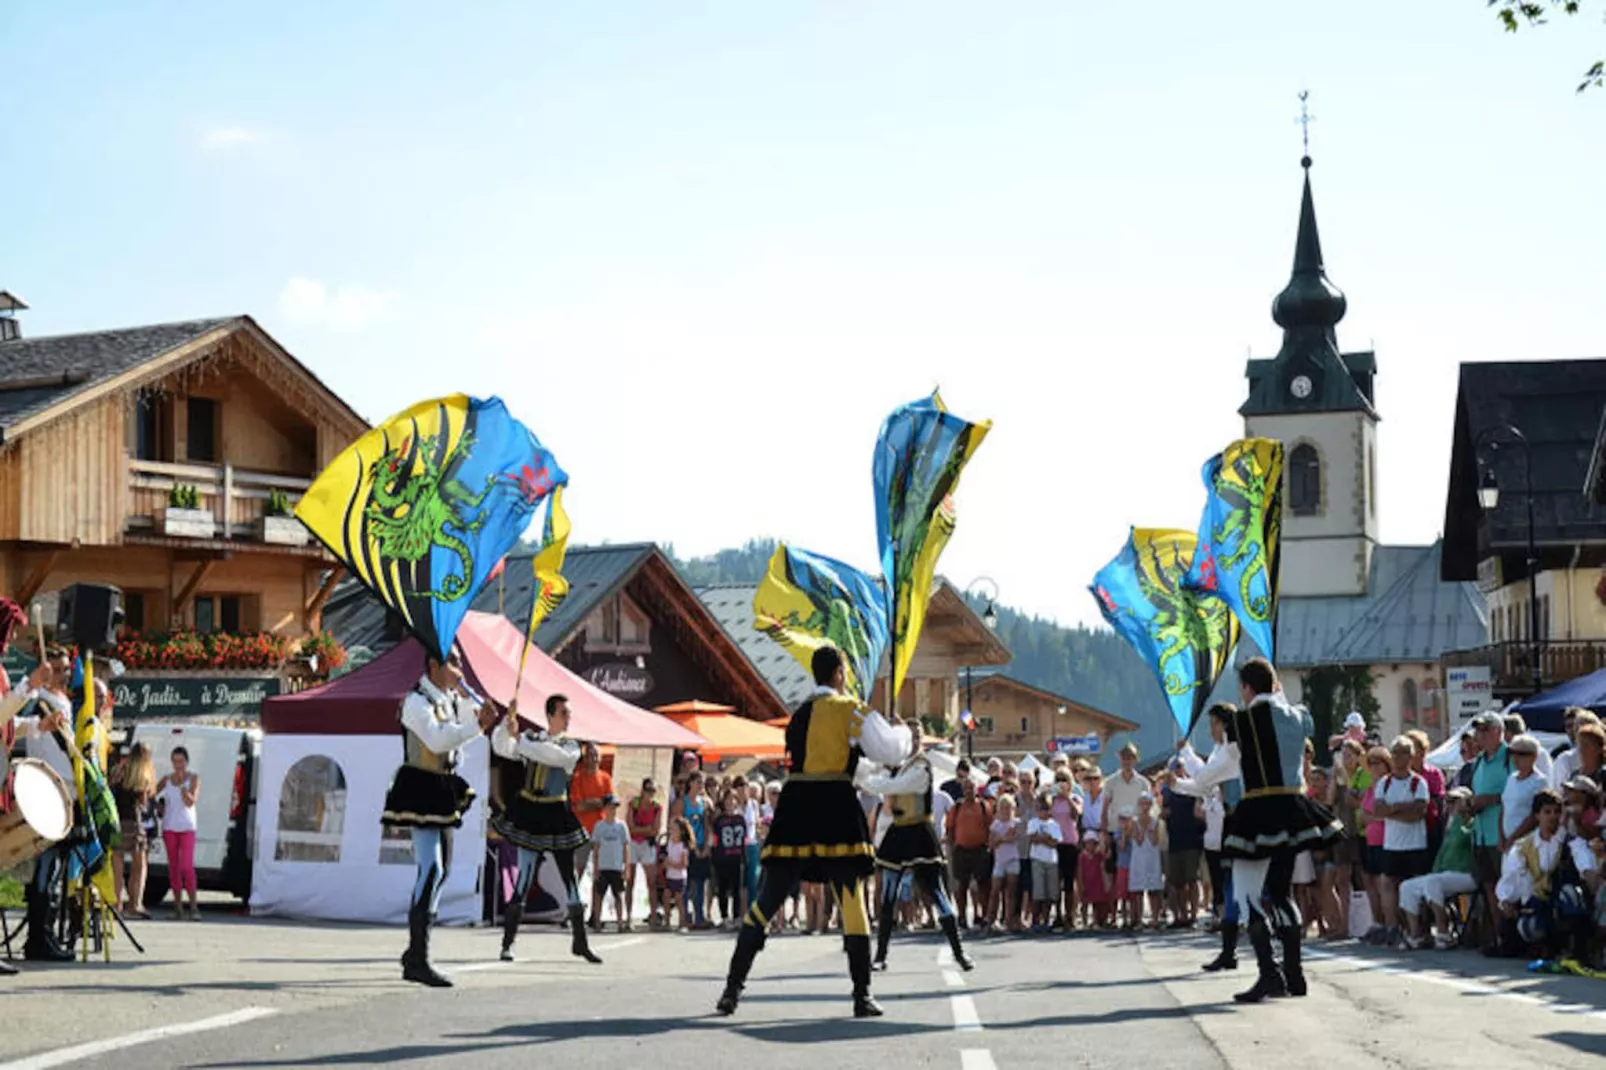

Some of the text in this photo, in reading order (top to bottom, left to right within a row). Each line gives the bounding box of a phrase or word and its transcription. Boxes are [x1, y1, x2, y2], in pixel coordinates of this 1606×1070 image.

[114, 684, 137, 707] De
[201, 685, 212, 706] à
[721, 824, 745, 848] 87
